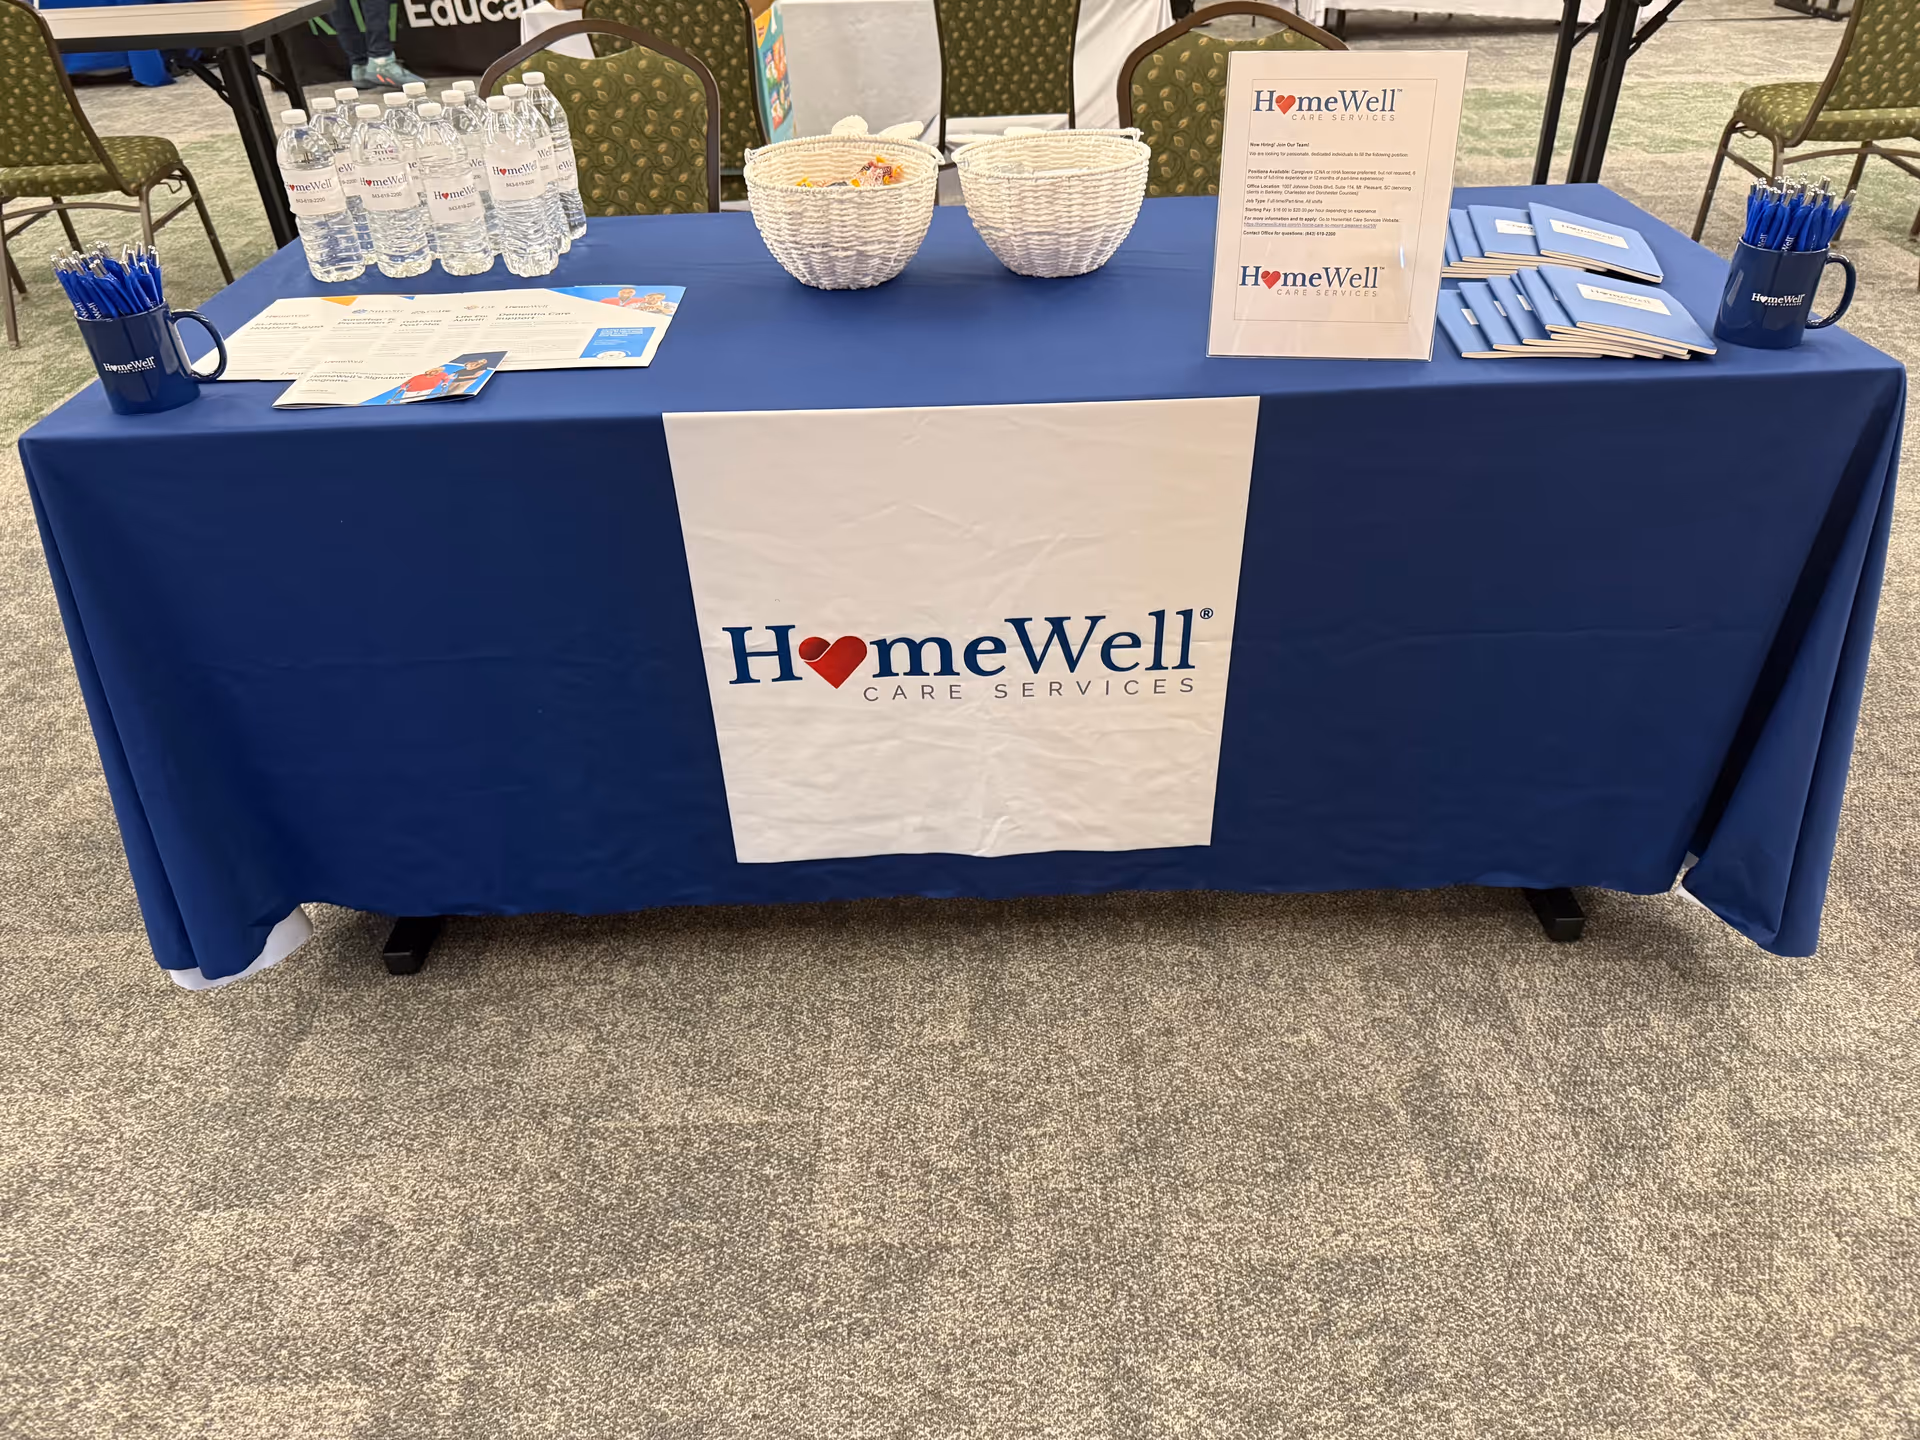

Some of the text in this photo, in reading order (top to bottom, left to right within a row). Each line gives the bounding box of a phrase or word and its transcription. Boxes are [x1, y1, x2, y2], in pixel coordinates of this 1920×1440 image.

[403, 0, 530, 28] Educa
[863, 677, 1195, 702] CARE SERVICES
